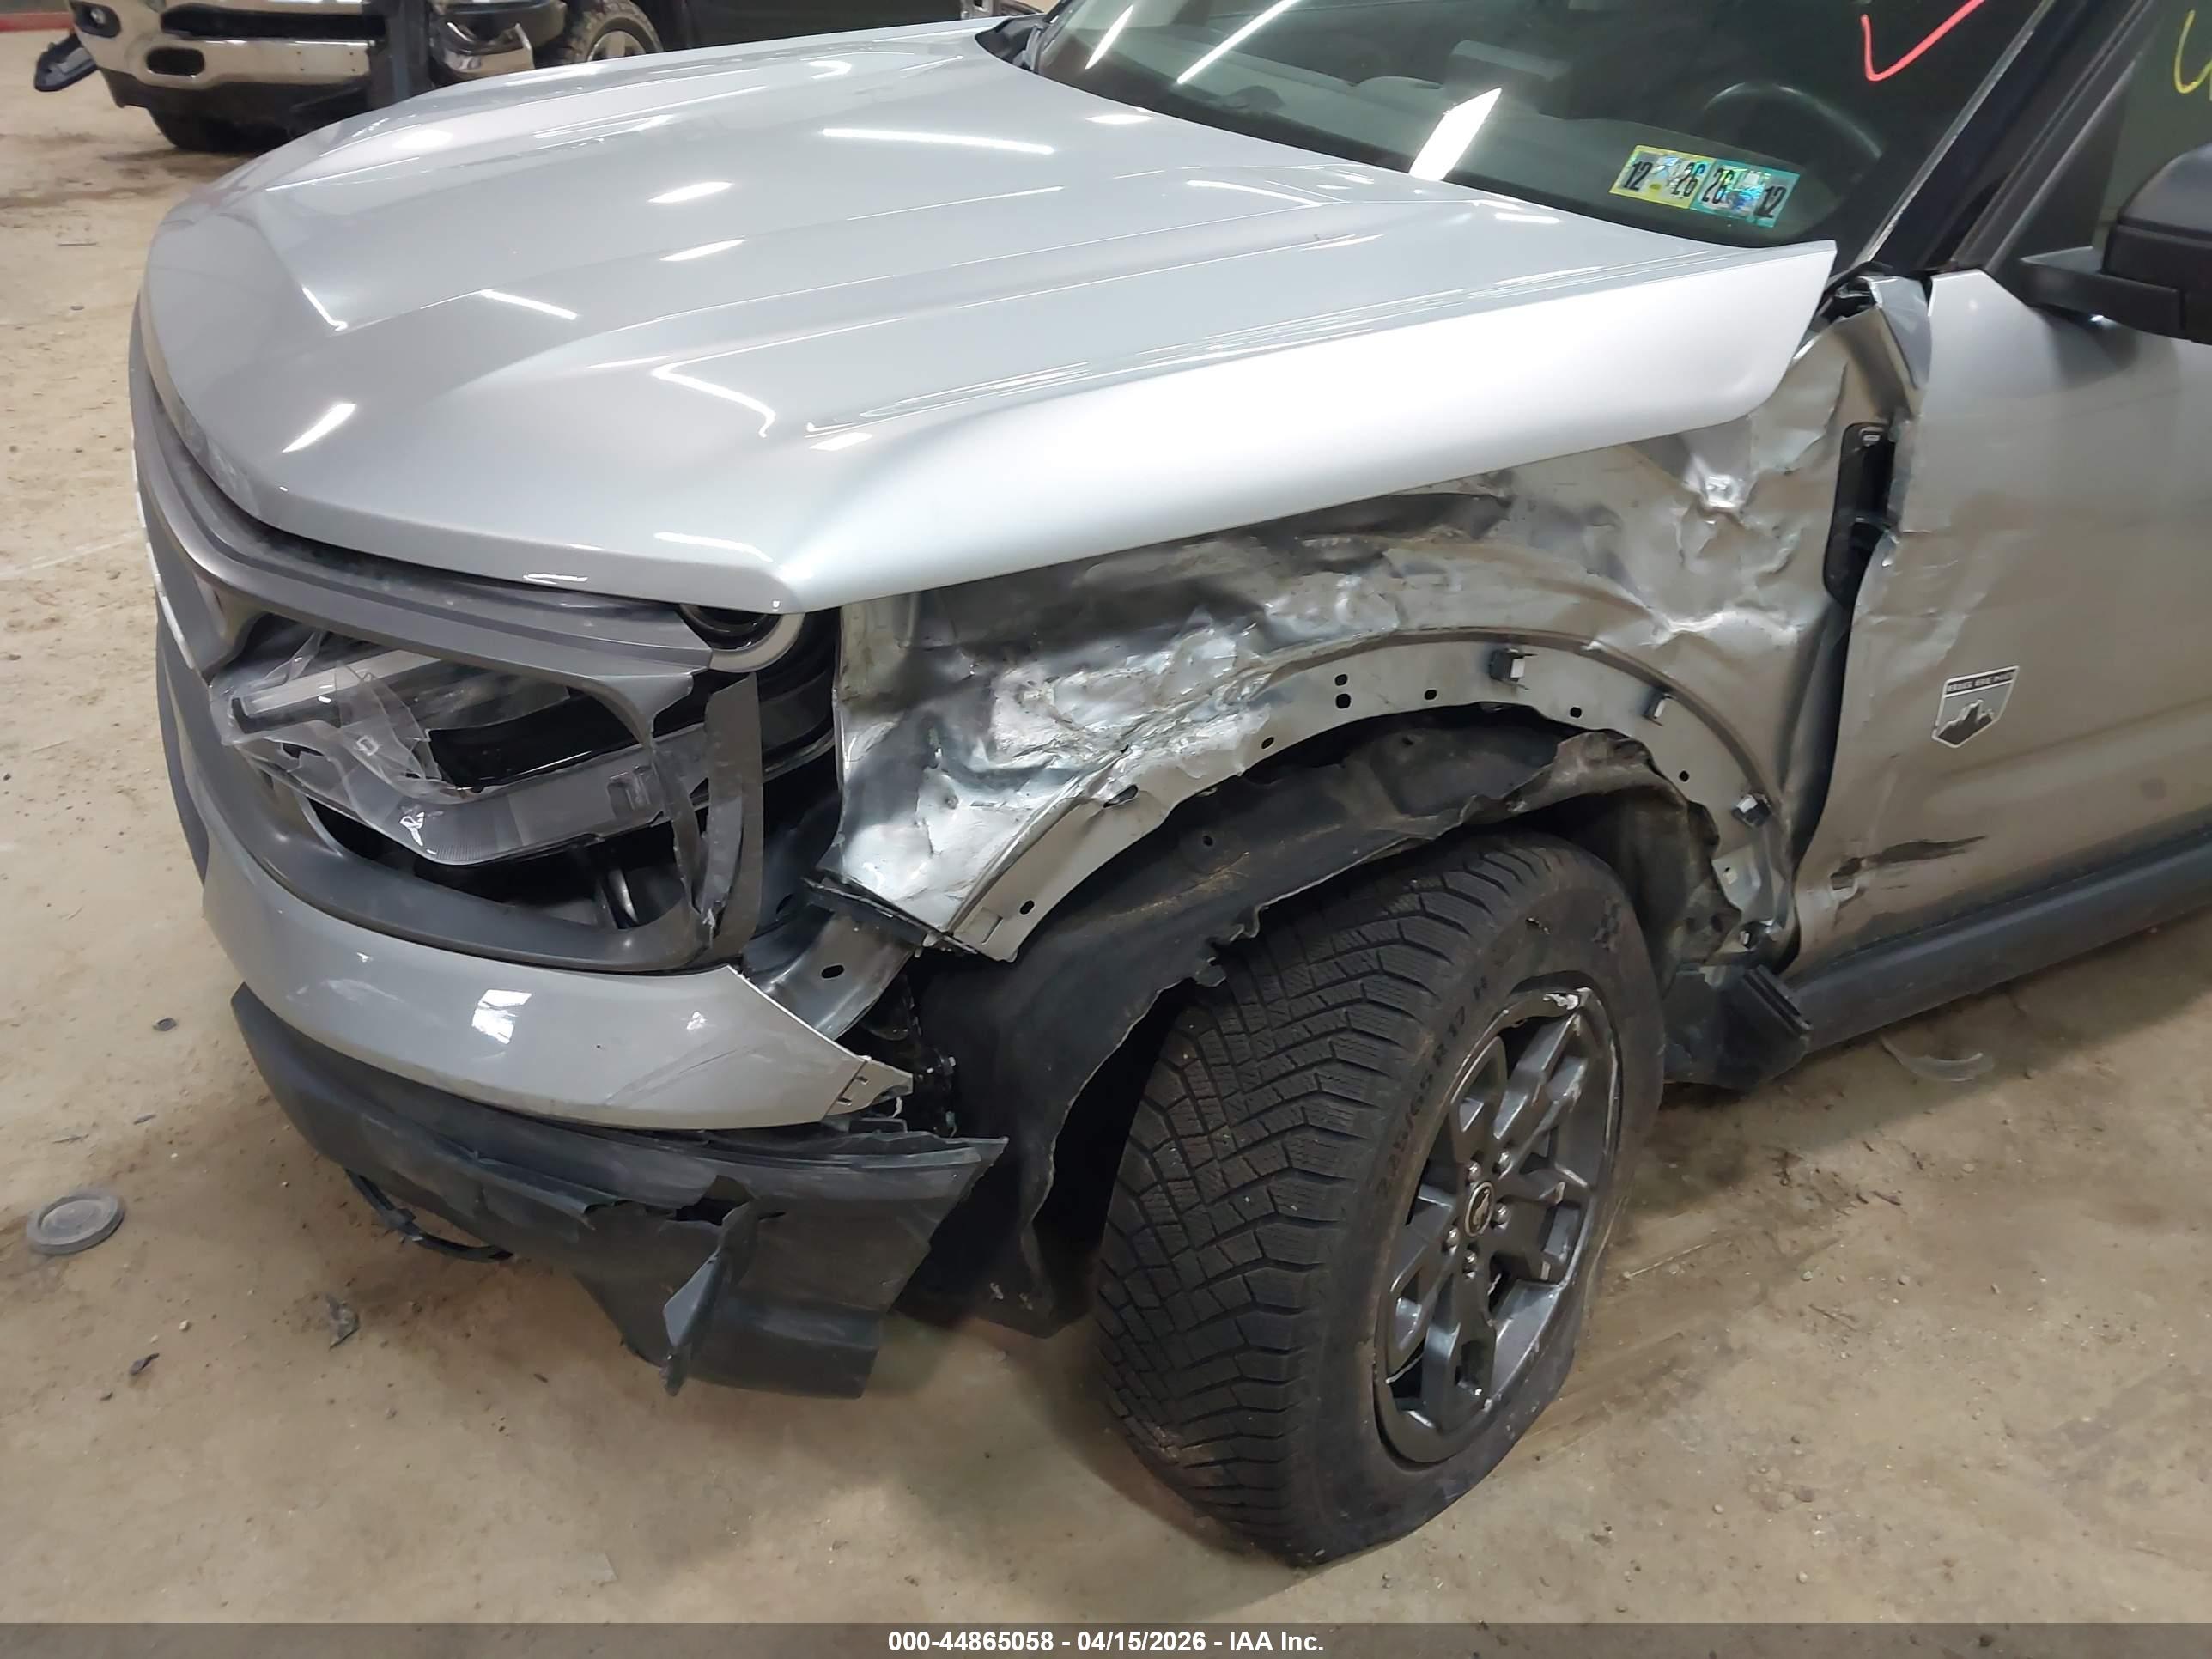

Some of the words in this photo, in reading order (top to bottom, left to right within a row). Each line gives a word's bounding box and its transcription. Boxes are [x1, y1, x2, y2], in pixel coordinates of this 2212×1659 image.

[1624, 161, 1653, 191] 12
[1755, 185, 1787, 218] 12
[1947, 681, 1973, 692] BIG
